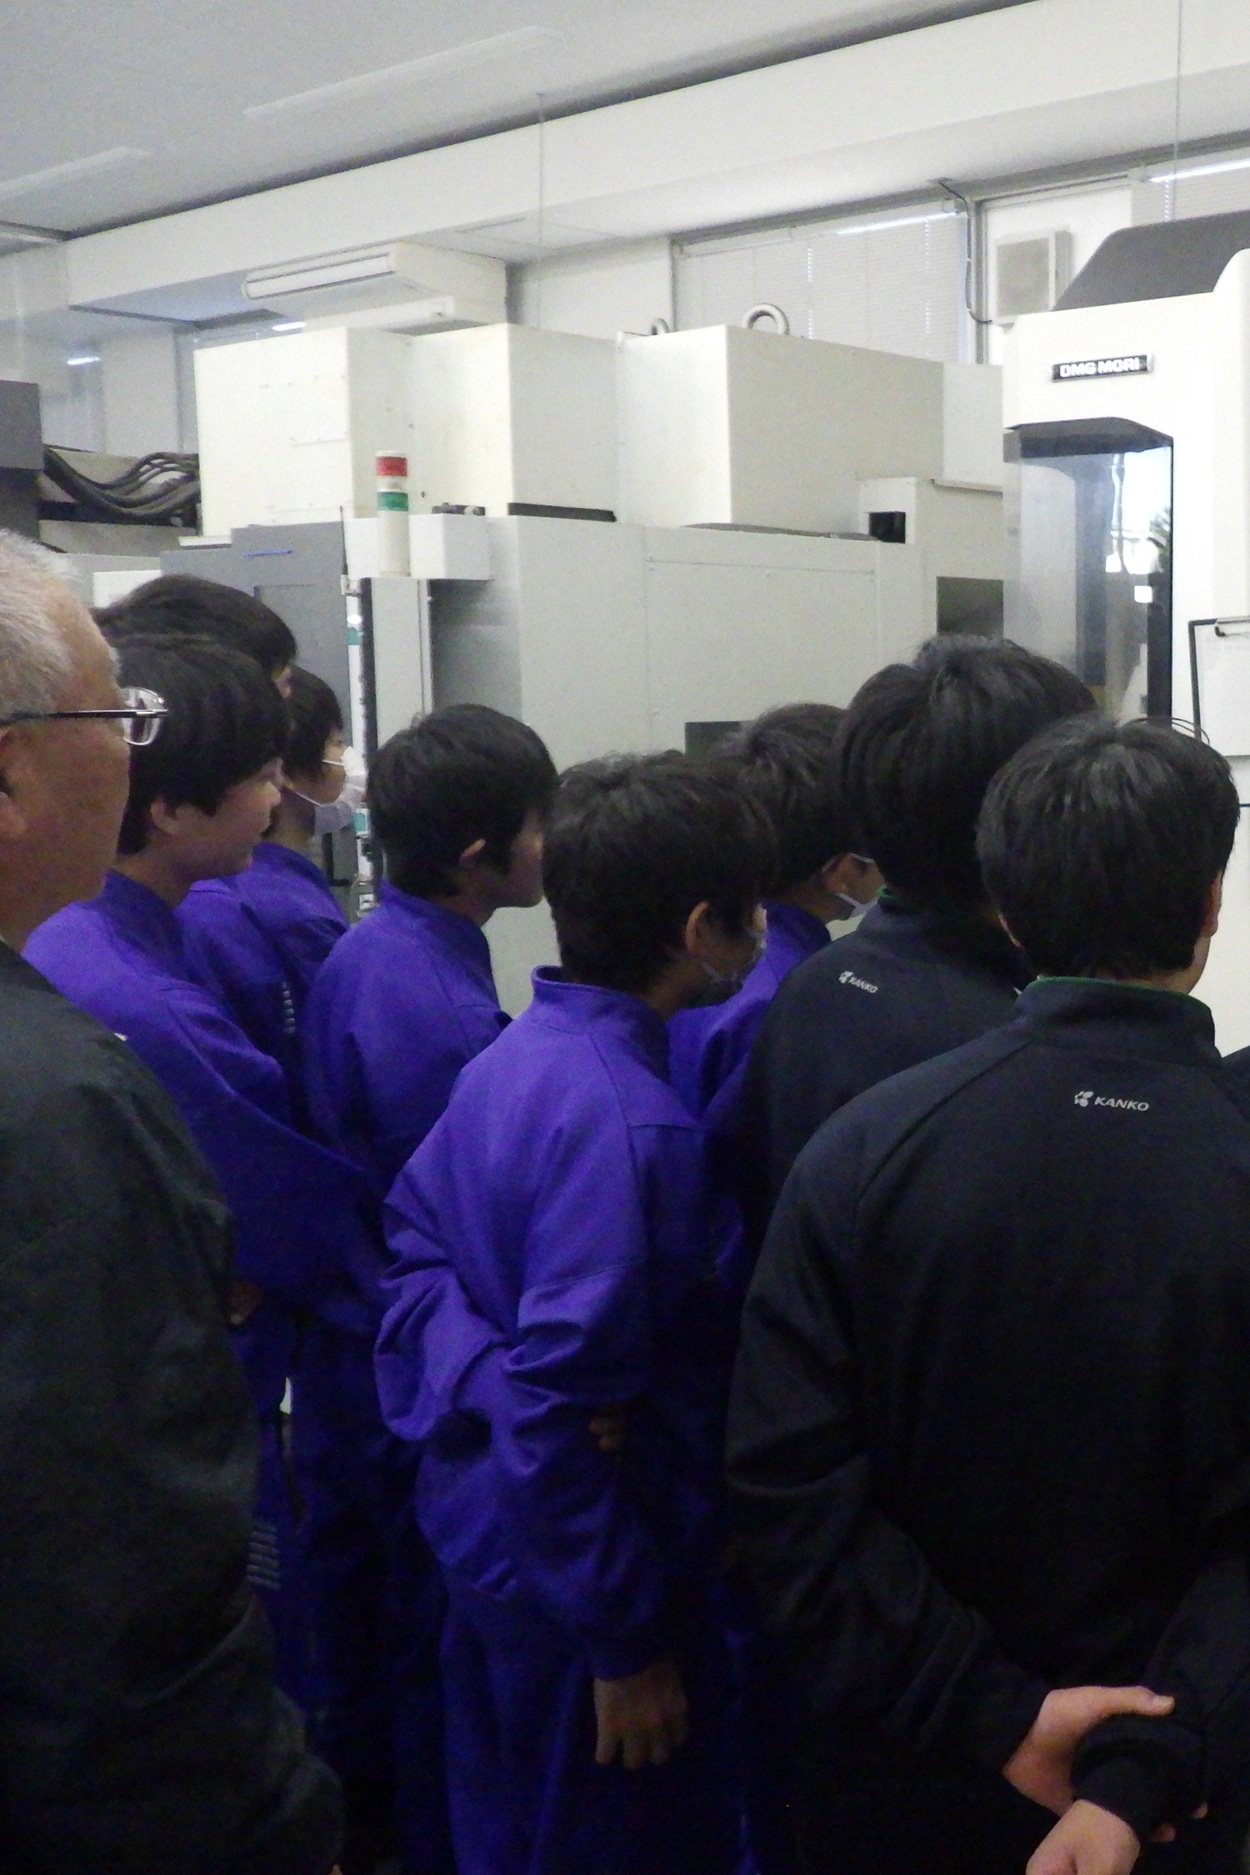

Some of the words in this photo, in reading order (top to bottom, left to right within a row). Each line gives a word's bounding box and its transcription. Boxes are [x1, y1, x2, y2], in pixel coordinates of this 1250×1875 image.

[1060, 362, 1097, 378] DMG
[1098, 357, 1140, 374] MORI
[1094, 1096, 1149, 1111] KANKO
